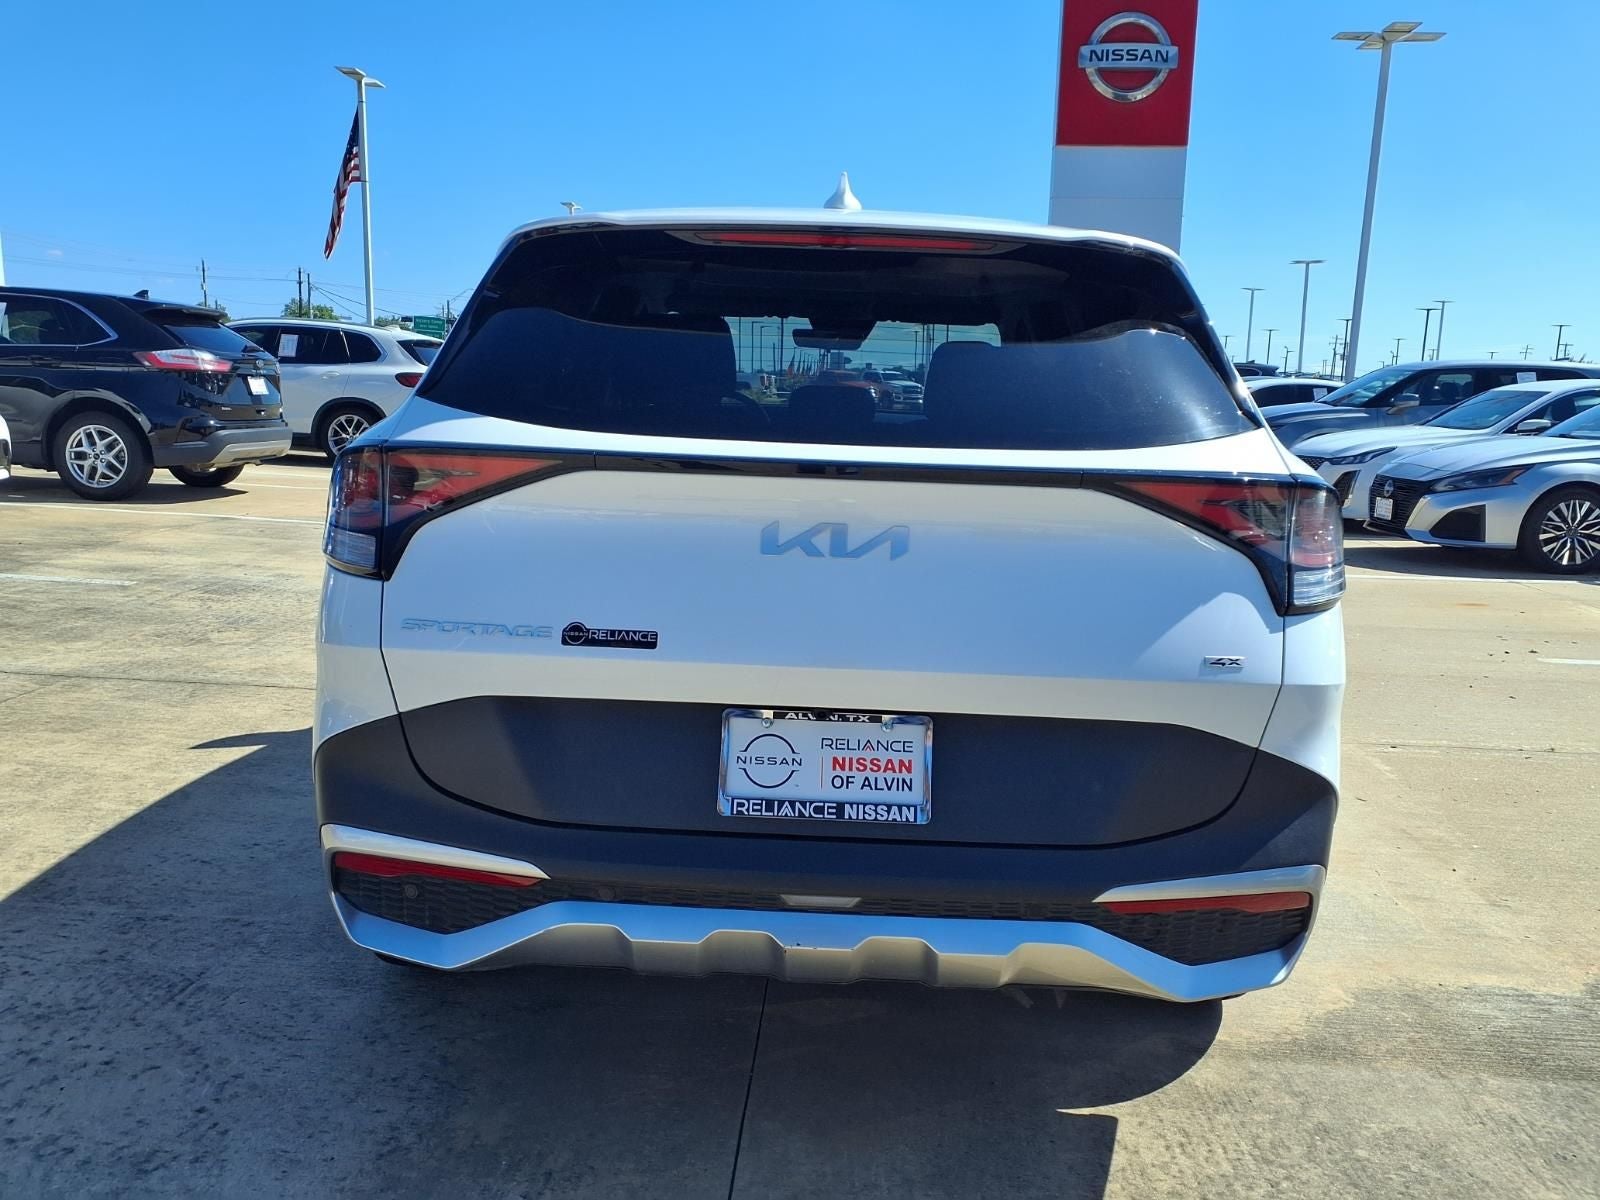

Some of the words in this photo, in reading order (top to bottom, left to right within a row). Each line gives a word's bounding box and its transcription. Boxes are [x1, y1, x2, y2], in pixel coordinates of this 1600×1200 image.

[1089, 48, 1169, 63] NISSAN
[760, 520, 910, 561] KIA
[401, 618, 554, 638] SPORTAGE
[589, 629, 657, 642] RELIANCE
[846, 714, 870, 723] TX
[821, 737, 914, 753] RELIANCE
[736, 755, 802, 767] NISSAN
[832, 756, 913, 774] NISSAN
[831, 774, 856, 790] OF
[860, 776, 913, 792] ALVIN
[733, 799, 836, 819] RELIANCE
[844, 803, 915, 822] NISSAN
